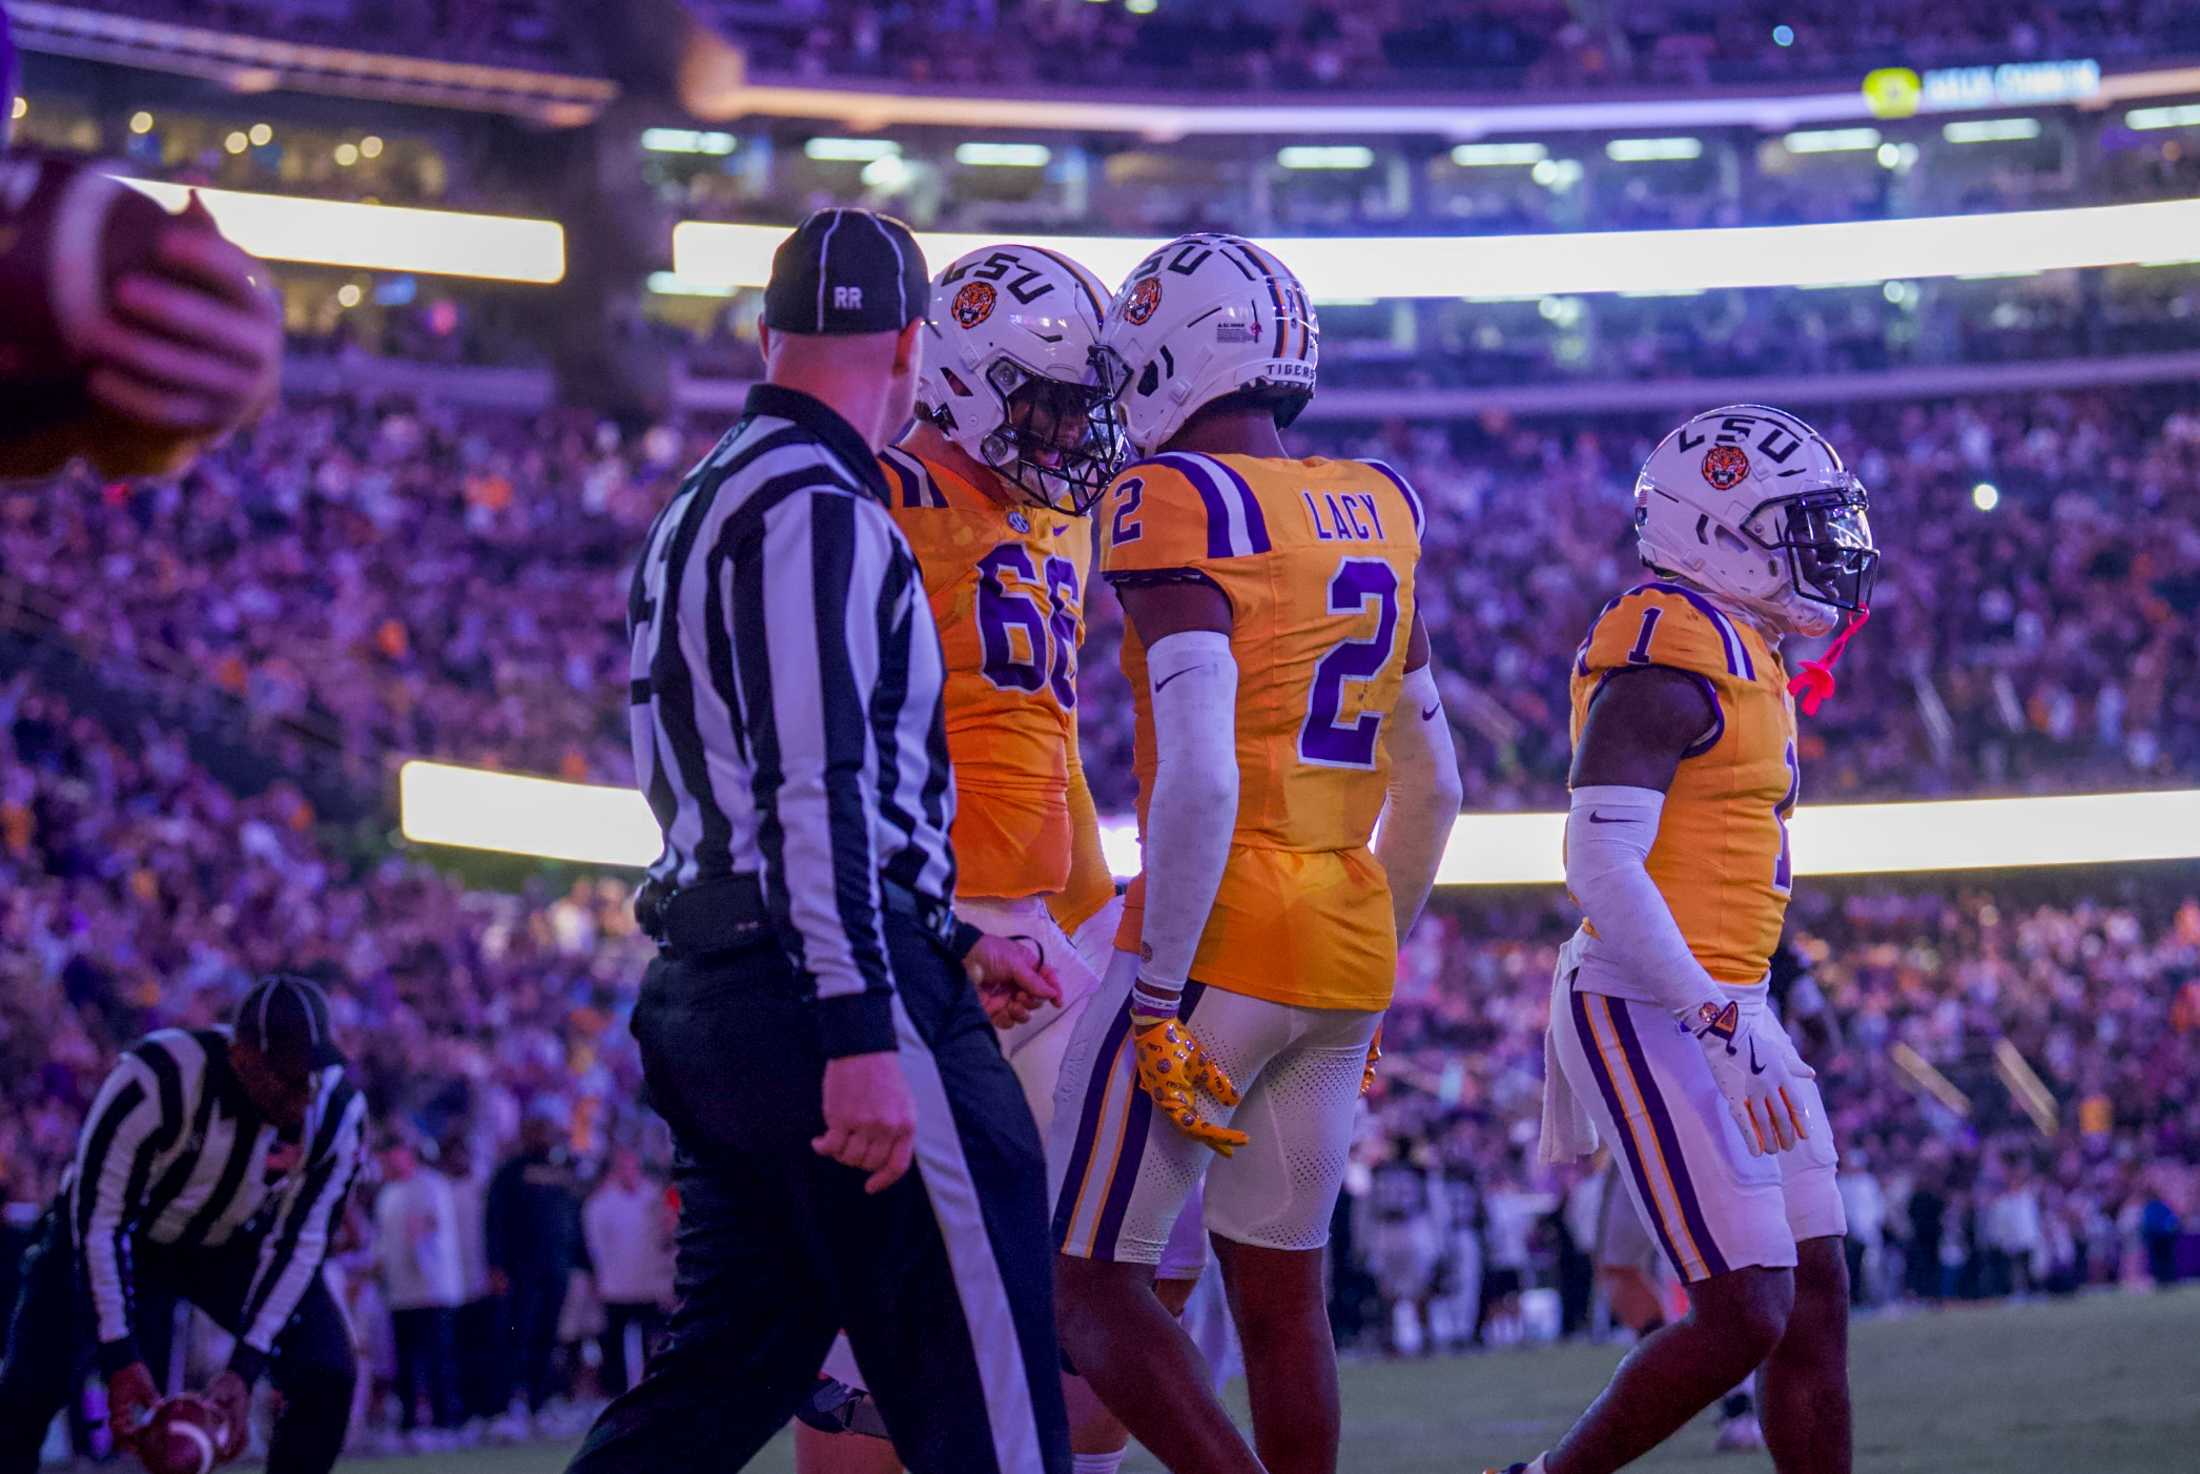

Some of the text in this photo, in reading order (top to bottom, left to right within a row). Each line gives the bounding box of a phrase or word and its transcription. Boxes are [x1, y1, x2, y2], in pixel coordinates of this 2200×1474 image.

[941, 252, 1056, 305] LSU
[1129, 244, 1214, 279] SU
[834, 286, 863, 310] RR
[1266, 363, 1316, 379] TIGERS
[1678, 417, 1801, 464] LSU
[1111, 476, 1145, 548] 2
[1303, 490, 1385, 541] LACY
[975, 541, 1079, 711] 66
[1626, 607, 1664, 665] 1
[1297, 555, 1399, 771] 2
